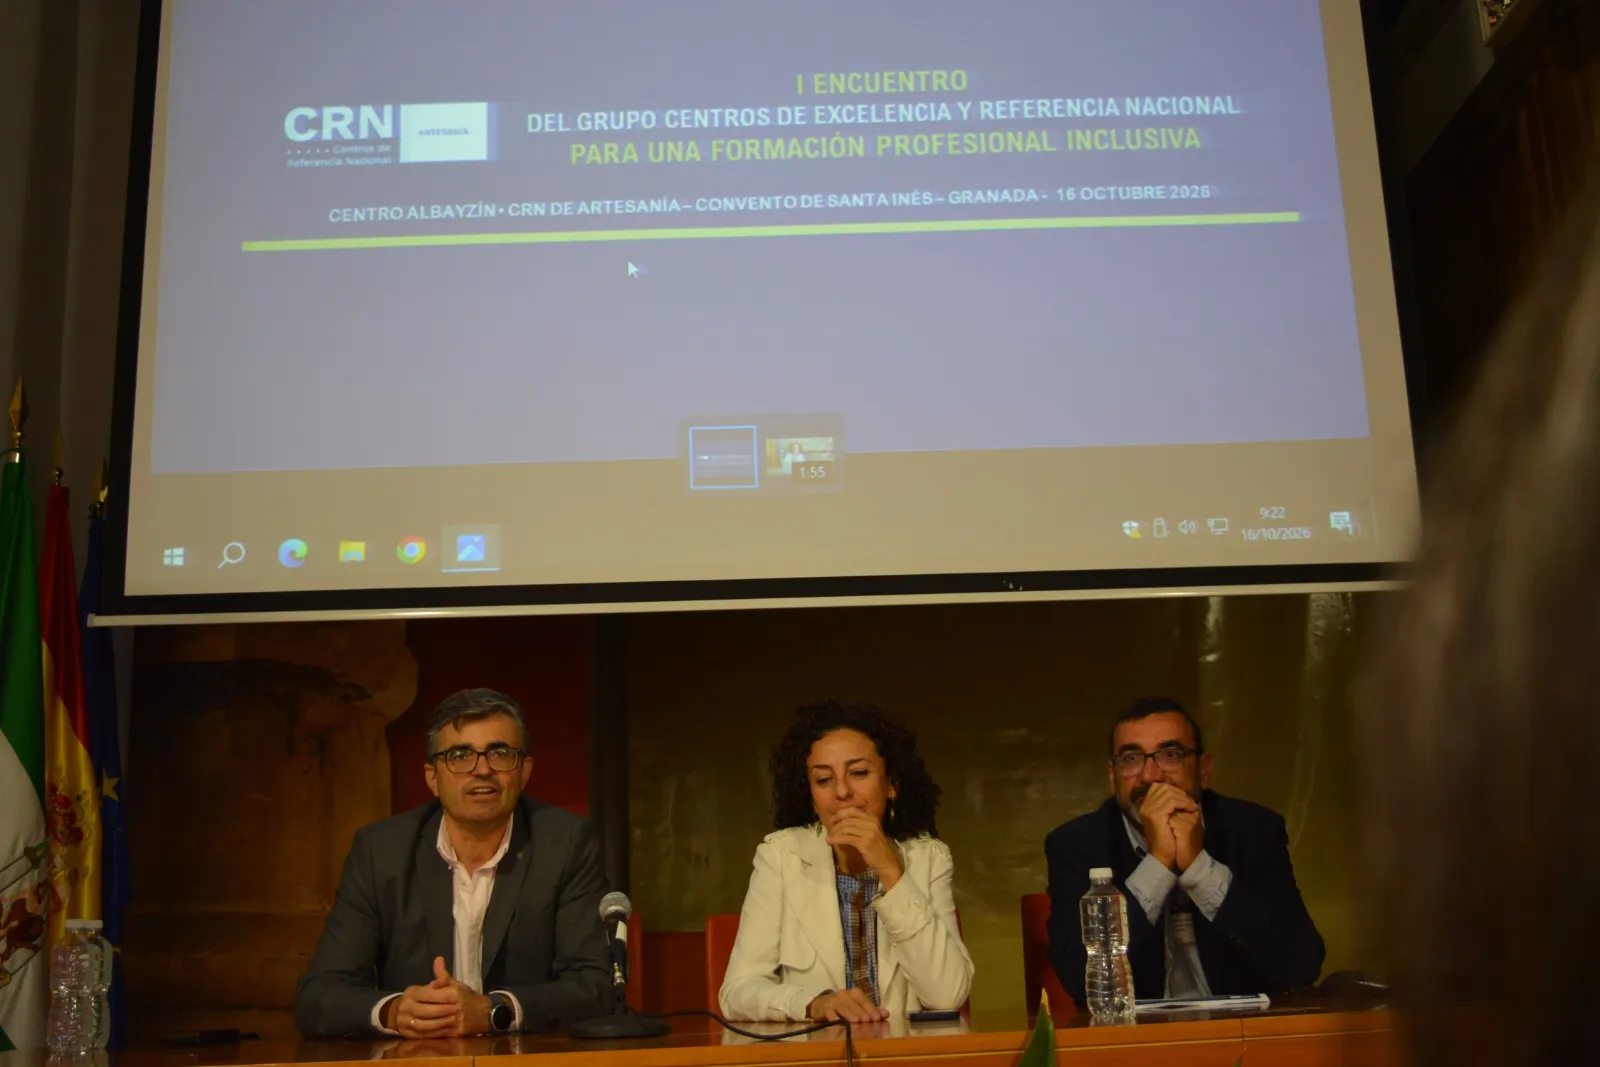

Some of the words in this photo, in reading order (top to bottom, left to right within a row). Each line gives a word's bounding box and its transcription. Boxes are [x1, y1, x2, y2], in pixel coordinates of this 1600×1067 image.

[797, 74, 803, 94] I
[813, 69, 968, 94] ENCUENTRO
[284, 104, 393, 142] CRN
[527, 112, 570, 133] DEL
[577, 110, 656, 131] GRUPO
[664, 107, 770, 129] CENTROS
[777, 106, 806, 126] DE
[814, 102, 952, 124] EXCELENCIA
[957, 101, 972, 121] Y
[980, 98, 1120, 120] REFERENCIA
[1125, 95, 1241, 116] NACIONAL
[332, 145, 374, 155] Centros
[377, 143, 391, 152] de
[571, 142, 639, 165] PARA
[649, 140, 701, 163] UNA
[711, 131, 865, 161] FORMACIÓN
[876, 130, 1057, 157] PROFESIONAL
[1066, 127, 1202, 151] INCLUSIVA
[286, 156, 342, 168] Referencia
[346, 155, 392, 165] Nacional
[328, 207, 404, 223] CENTRO
[406, 200, 496, 219] ALBAYZÍN
[508, 202, 546, 217] CRN
[550, 201, 574, 215] DE
[576, 196, 681, 215] ARTESANÍA
[695, 196, 797, 212] CONVENTO
[800, 194, 825, 209] DE
[827, 193, 889, 208] SANTA
[892, 189, 934, 206] INÉS
[948, 188, 1039, 204] GRANADA
[1056, 187, 1076, 201] 16
[1080, 185, 1167, 201] OCTUBRE
[1169, 185, 1211, 199] 2026
[799, 466, 826, 479] 1:55
[1259, 506, 1286, 520] 9:22
[1241, 527, 1311, 541] 16/10/2026
